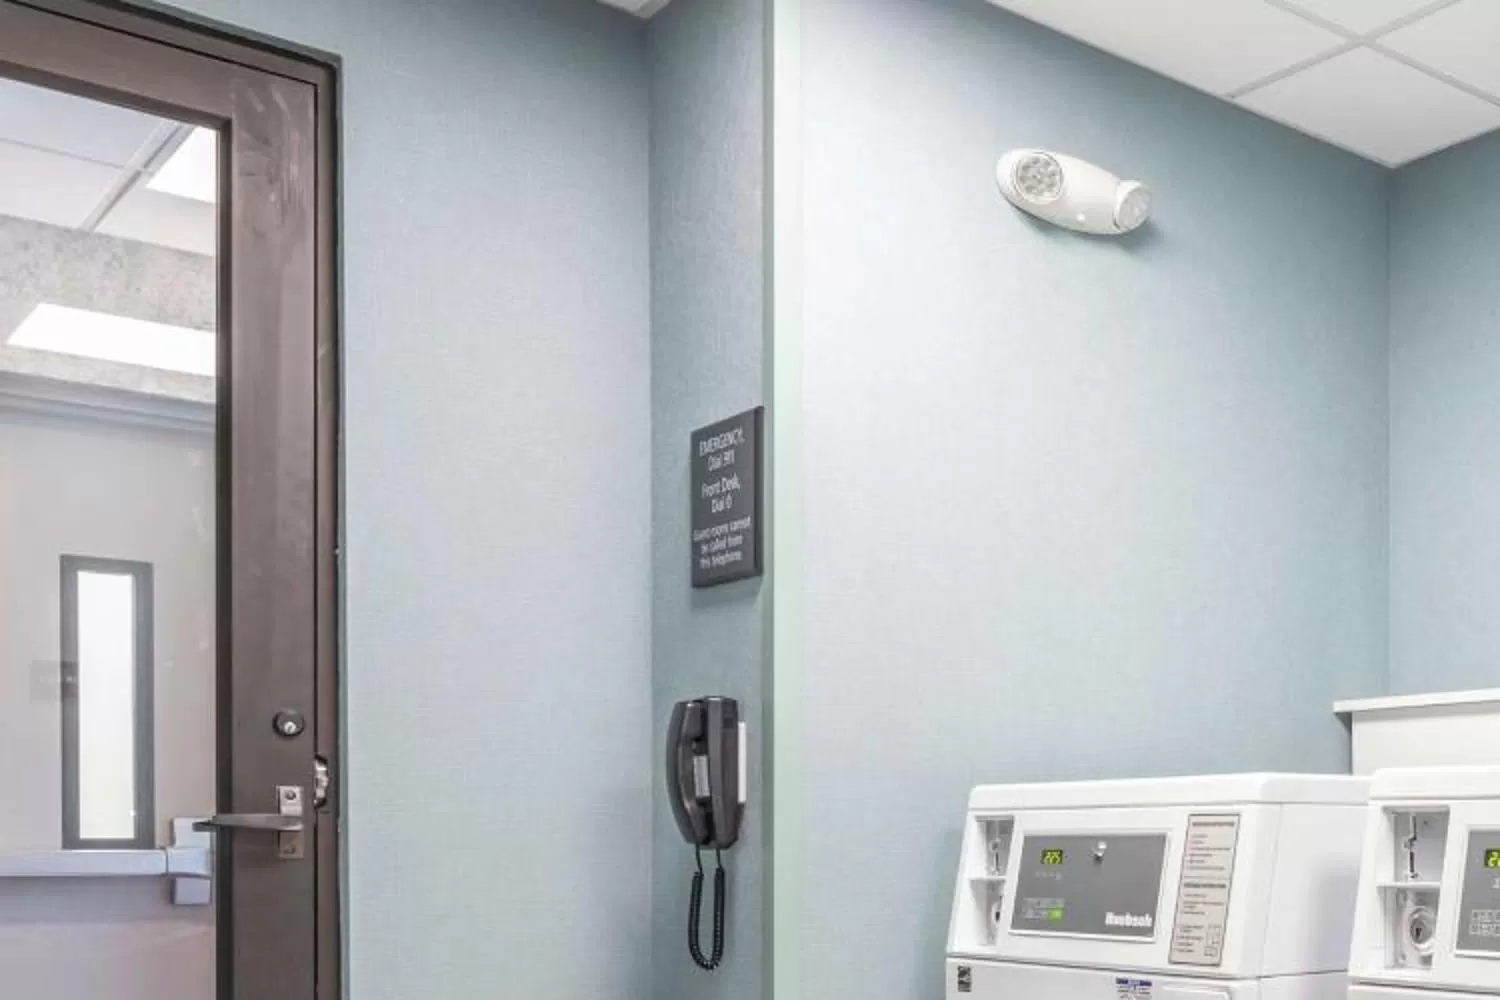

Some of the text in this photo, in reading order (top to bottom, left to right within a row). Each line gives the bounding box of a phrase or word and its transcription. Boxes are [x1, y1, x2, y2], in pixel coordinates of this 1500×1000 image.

[708, 454, 722, 472] Dial
[701, 480, 721, 498] Front
[711, 497, 725, 513] Dial
